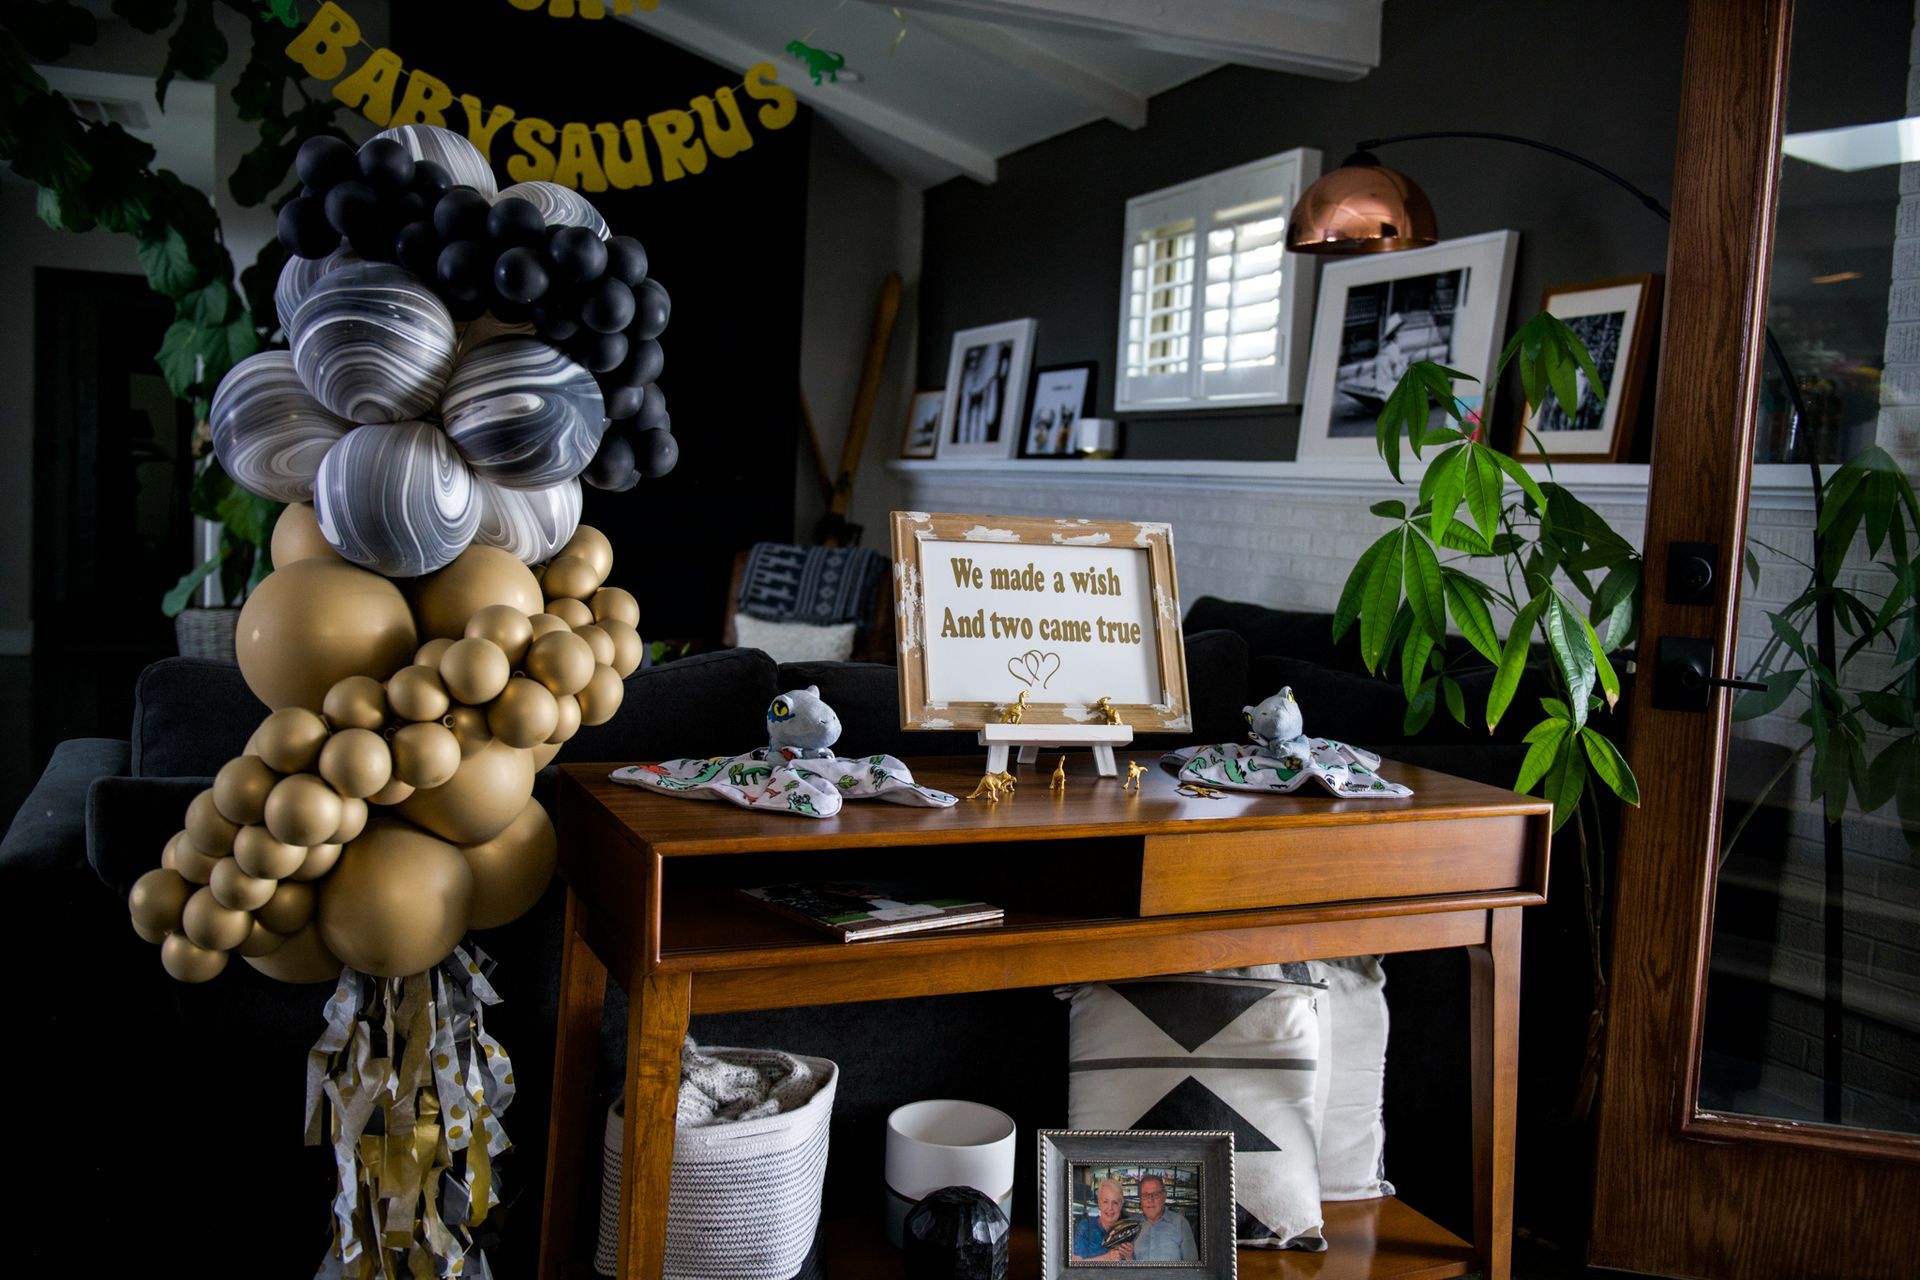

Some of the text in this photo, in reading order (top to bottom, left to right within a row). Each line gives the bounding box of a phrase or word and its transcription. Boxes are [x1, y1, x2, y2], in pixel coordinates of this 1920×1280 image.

[285, 0, 798, 192] BABYSAURUS
[950, 557, 1122, 596] We made a wish
[940, 606, 1142, 645] And two came true
